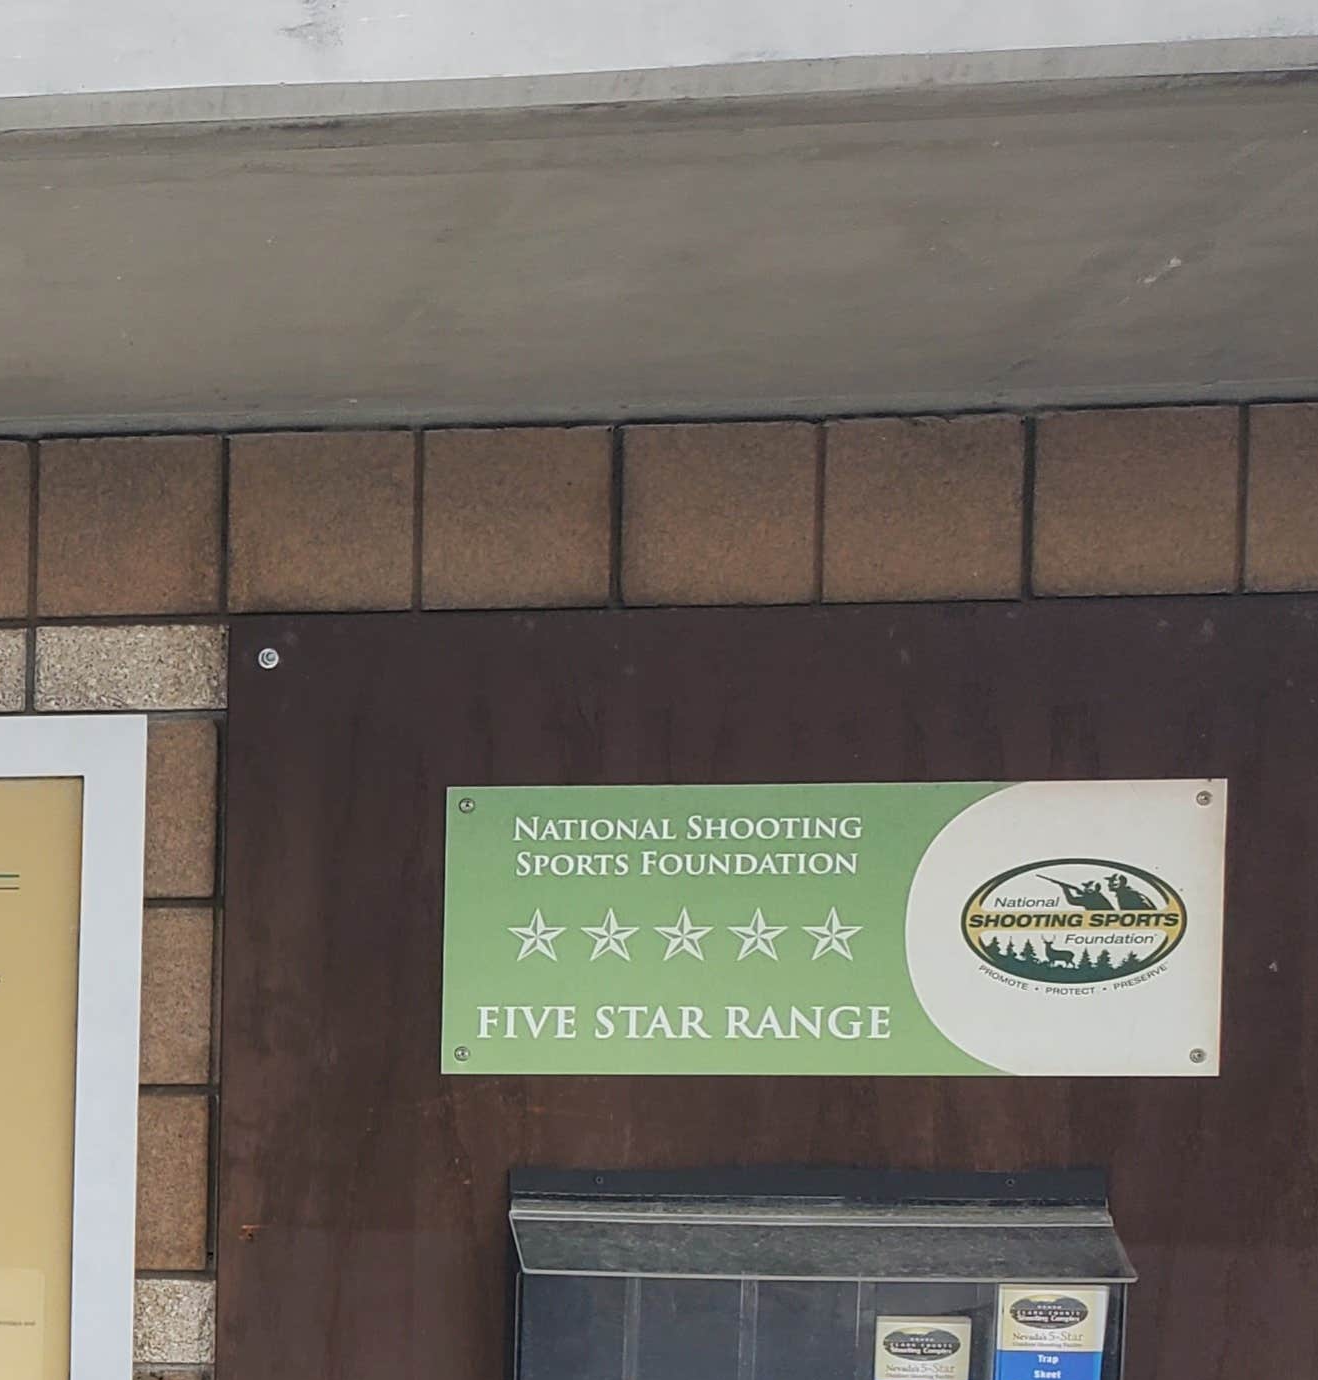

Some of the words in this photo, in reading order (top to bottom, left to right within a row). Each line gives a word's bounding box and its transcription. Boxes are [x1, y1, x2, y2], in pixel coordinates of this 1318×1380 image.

[513, 816, 676, 842] NATIONAL
[686, 815, 862, 840] SHOOTING
[515, 851, 629, 877] SPORTS
[640, 851, 859, 876] FOUNDATION
[994, 897, 1059, 907] National
[969, 914, 1082, 928] SHOOTING
[1088, 913, 1179, 927] SPORTS
[1065, 933, 1154, 945] Foundation
[978, 964, 1028, 990] PROMOTE
[1045, 987, 1095, 996] PROTECT
[1113, 964, 1167, 990] PRESERVE
[477, 1005, 577, 1039] FIVE
[595, 1005, 715, 1040] STAR
[724, 1005, 892, 1040] RANGE
[1037, 1354, 1059, 1365] Trap
[1033, 1369, 1061, 1379] Skeet
